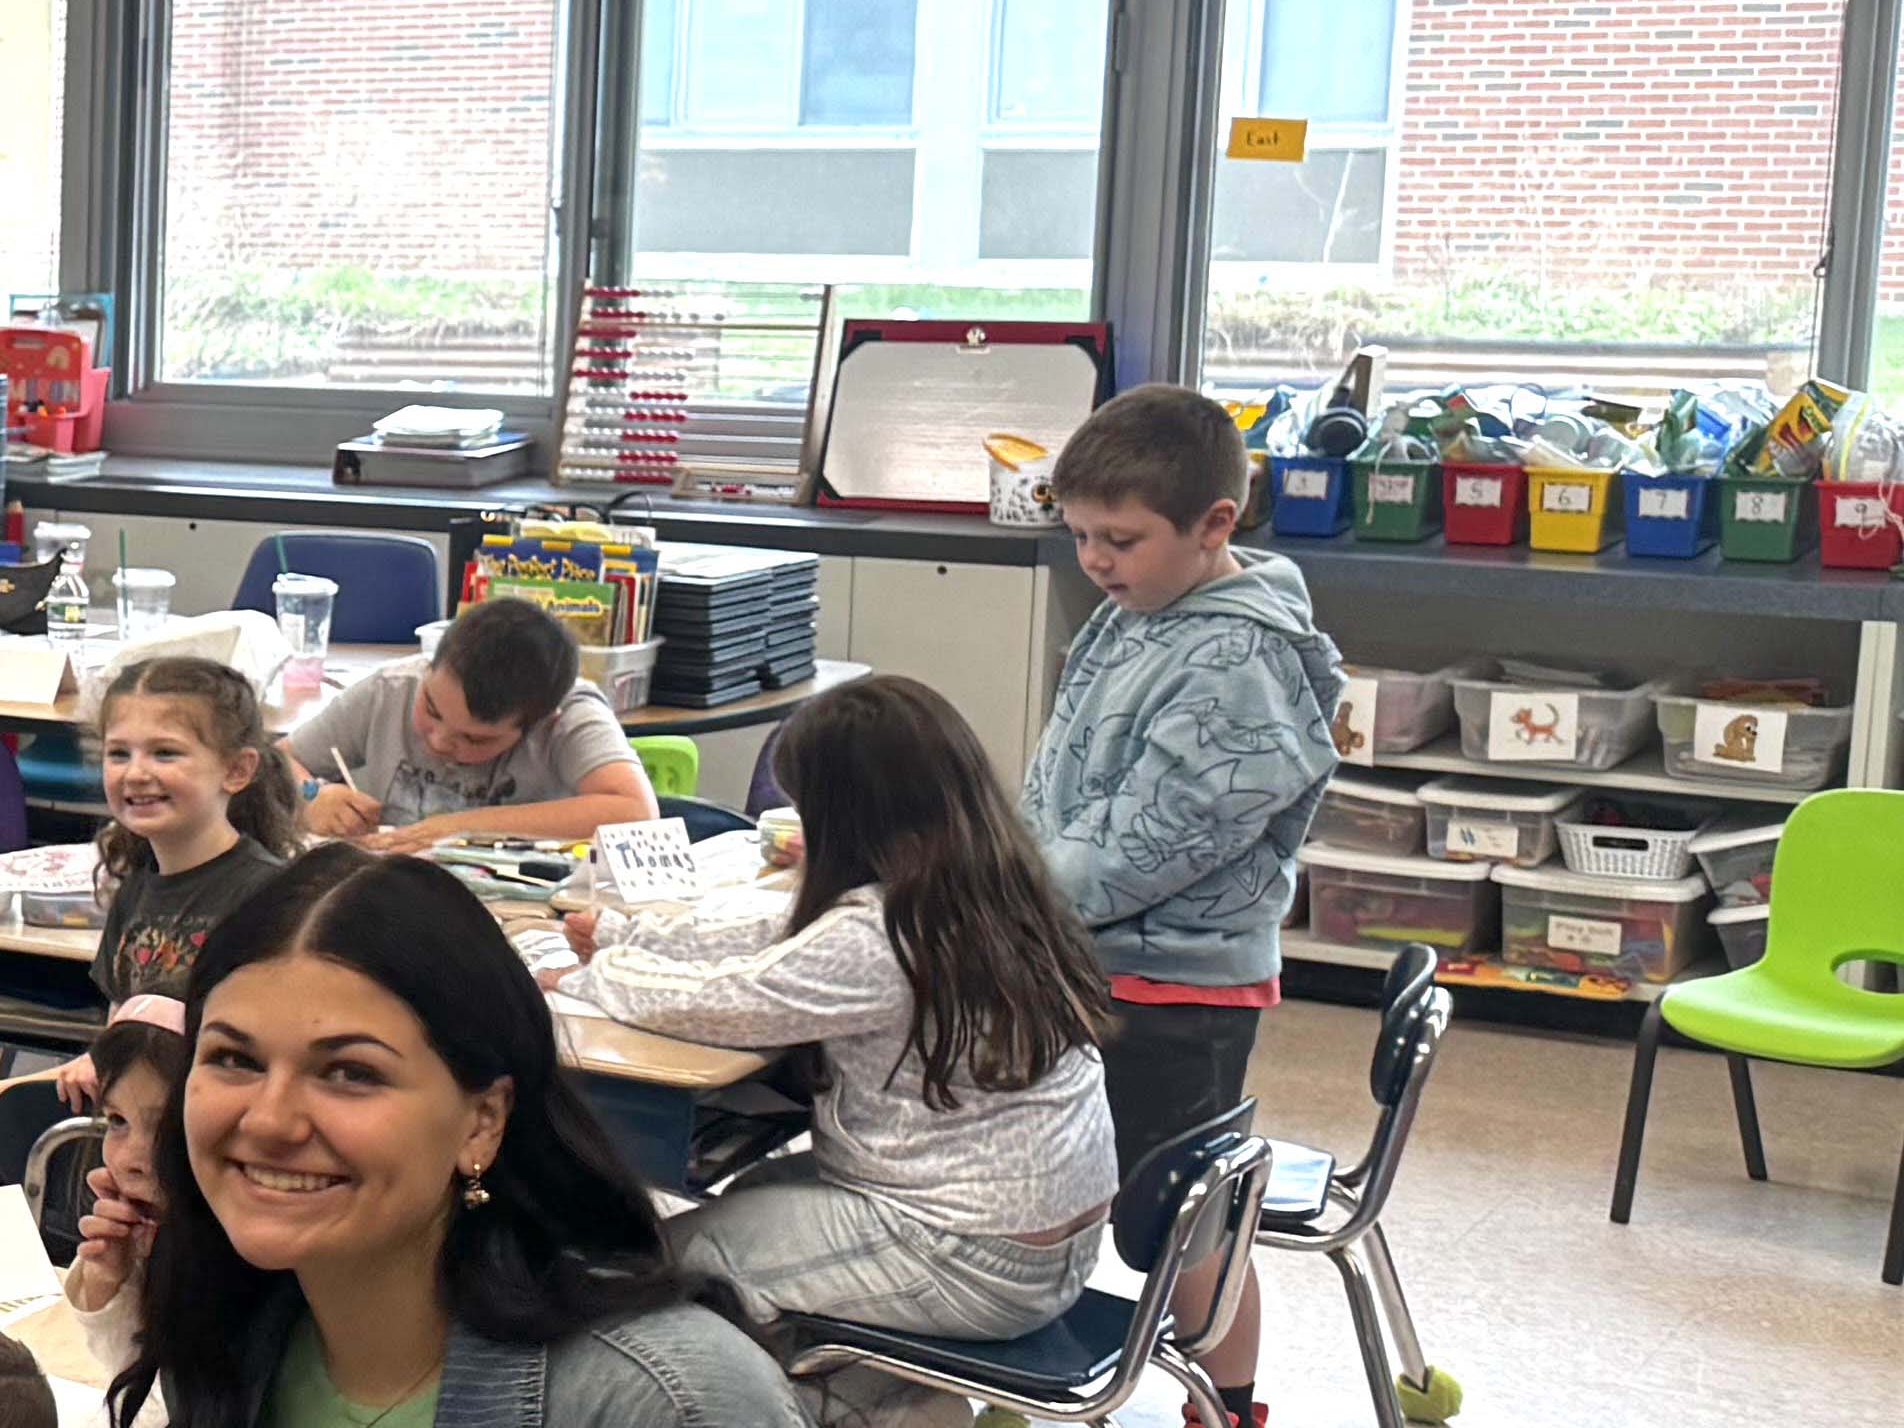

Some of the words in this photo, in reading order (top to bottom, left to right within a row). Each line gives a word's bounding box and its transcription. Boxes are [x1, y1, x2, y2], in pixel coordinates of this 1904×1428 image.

[1558, 488, 1573, 508] 6
[1655, 491, 1668, 511] 7
[1752, 495, 1763, 514] 8
[548, 600, 600, 612] Animals
[616, 840, 695, 872] Thomas
